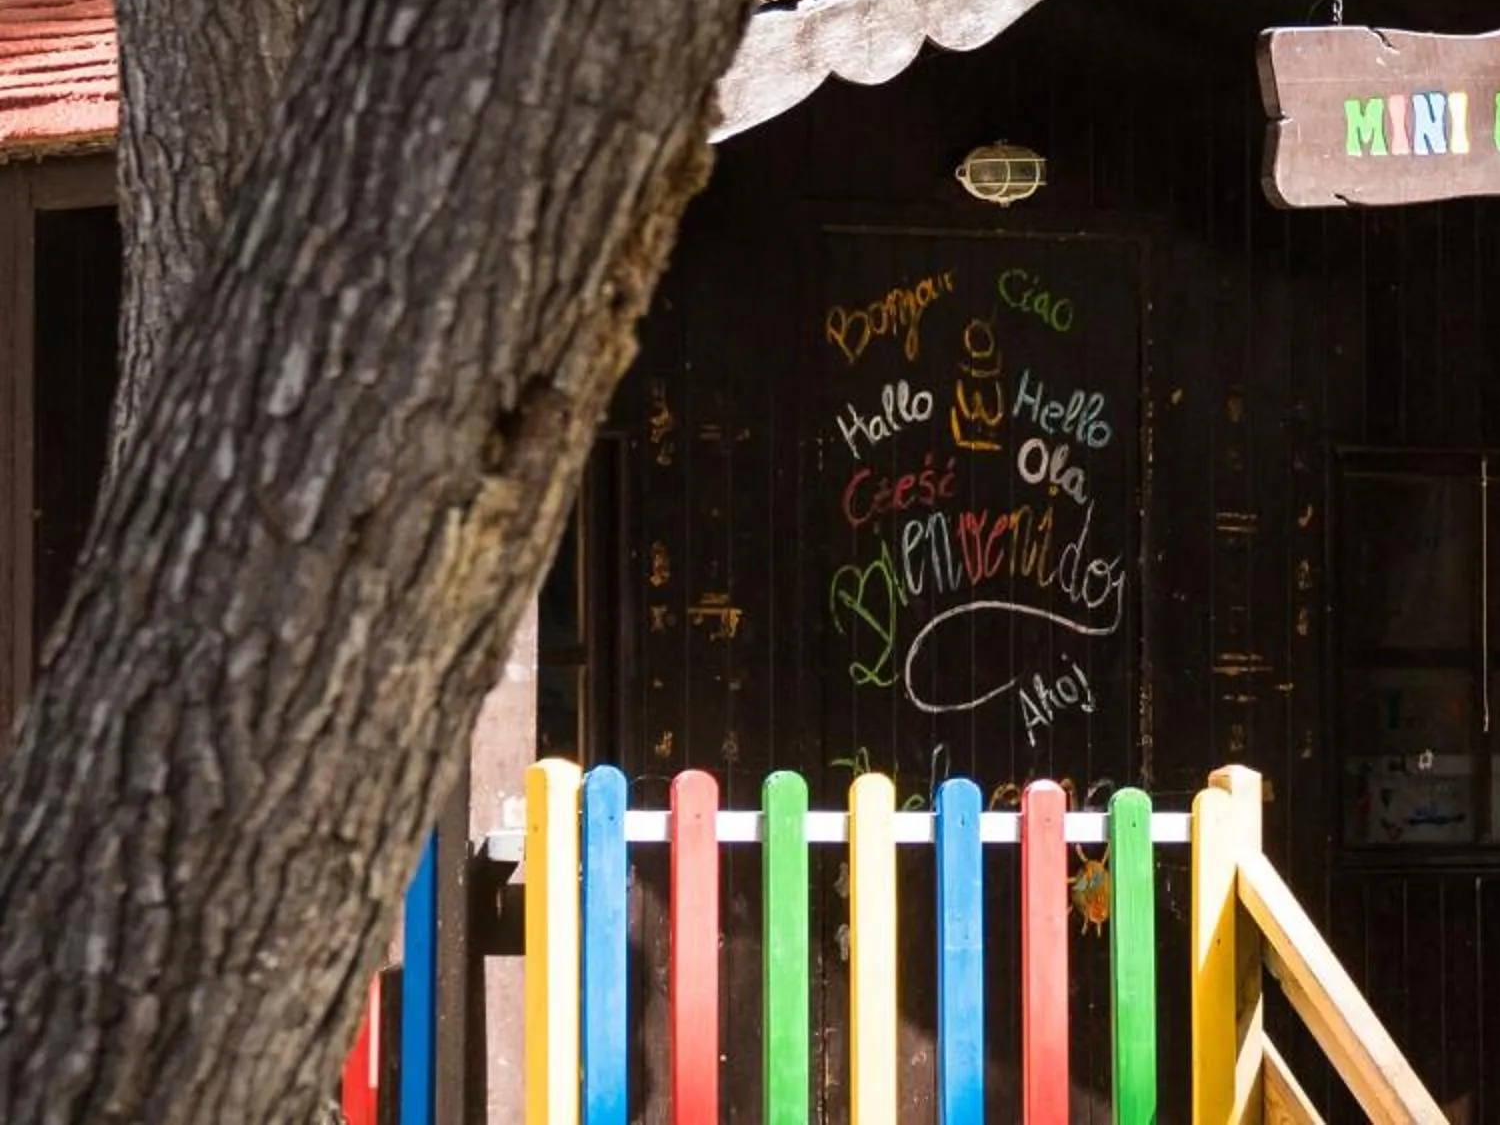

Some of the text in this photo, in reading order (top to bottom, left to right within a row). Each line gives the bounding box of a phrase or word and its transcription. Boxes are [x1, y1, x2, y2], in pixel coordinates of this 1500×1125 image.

[1344, 91, 1469, 156] MINI
[999, 268, 1074, 332] Ciao
[836, 378, 934, 459] Hallo
[1012, 369, 1113, 448] Hello
[1018, 437, 1088, 505] Ola
[829, 498, 1126, 688] Bienvenidos
